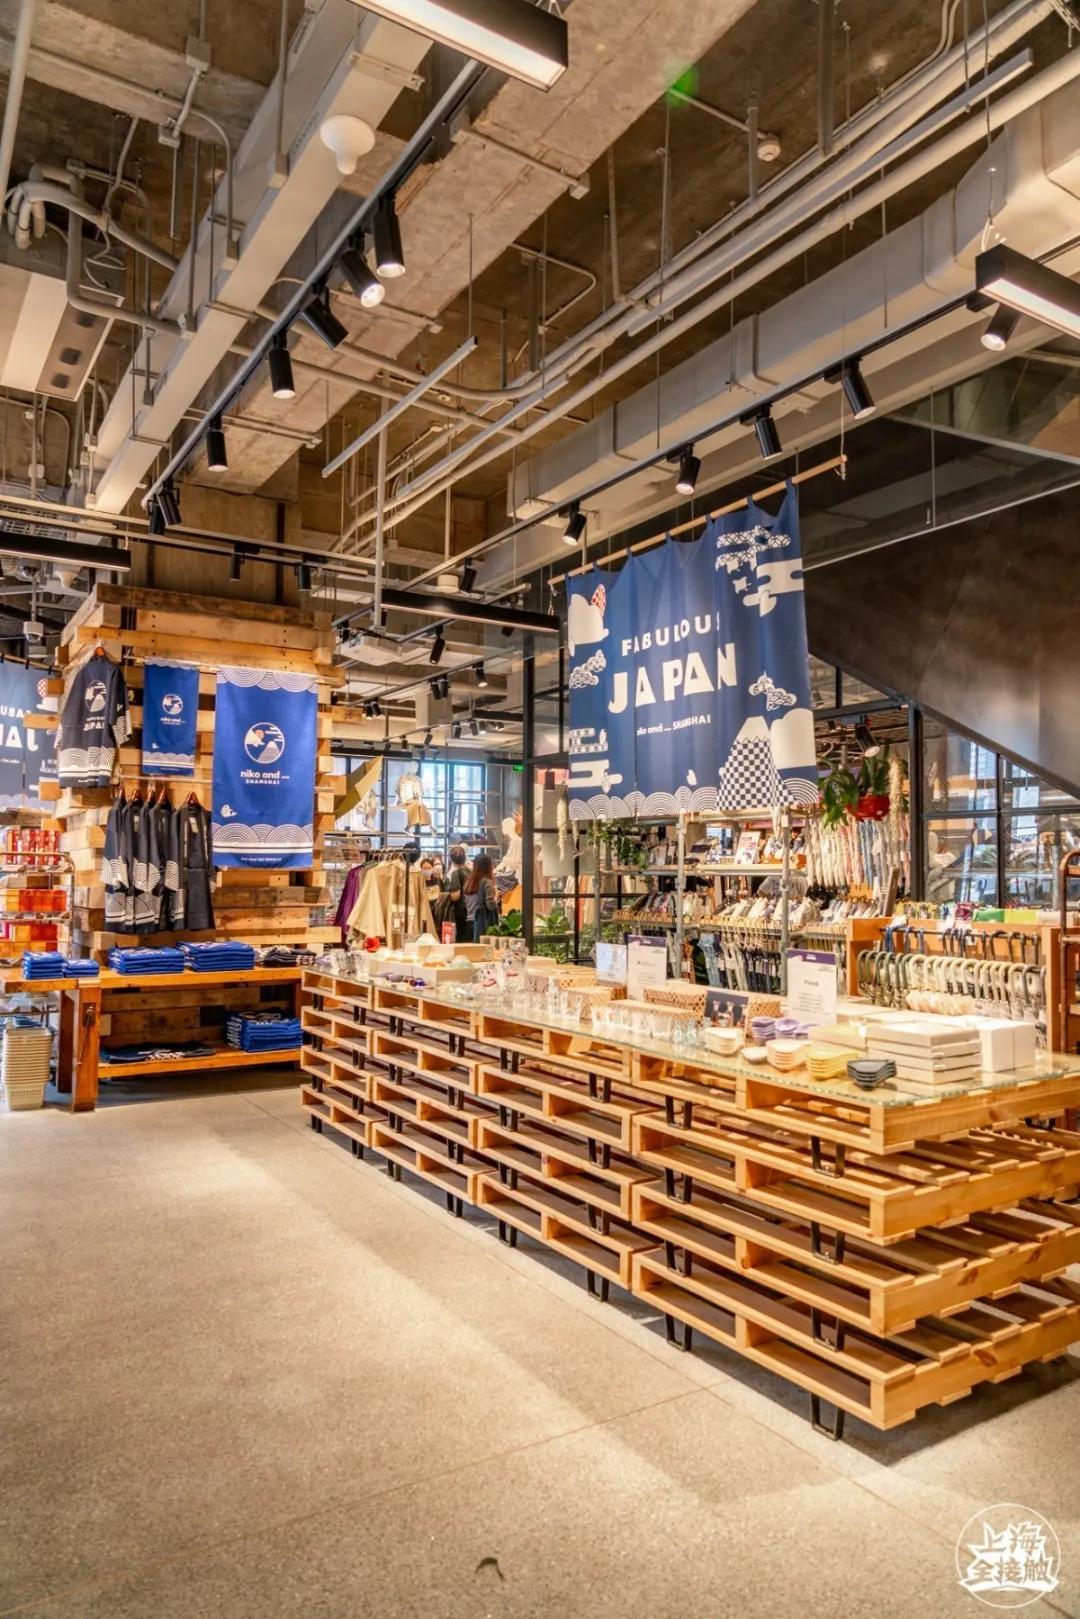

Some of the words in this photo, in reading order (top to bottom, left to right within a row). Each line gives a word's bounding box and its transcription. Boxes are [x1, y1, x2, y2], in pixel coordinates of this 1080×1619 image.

[621, 611, 720, 656] FABULOU
[608, 643, 737, 714] JAPAN
[240, 769, 261, 779] niko
[262, 770, 280, 779] and
